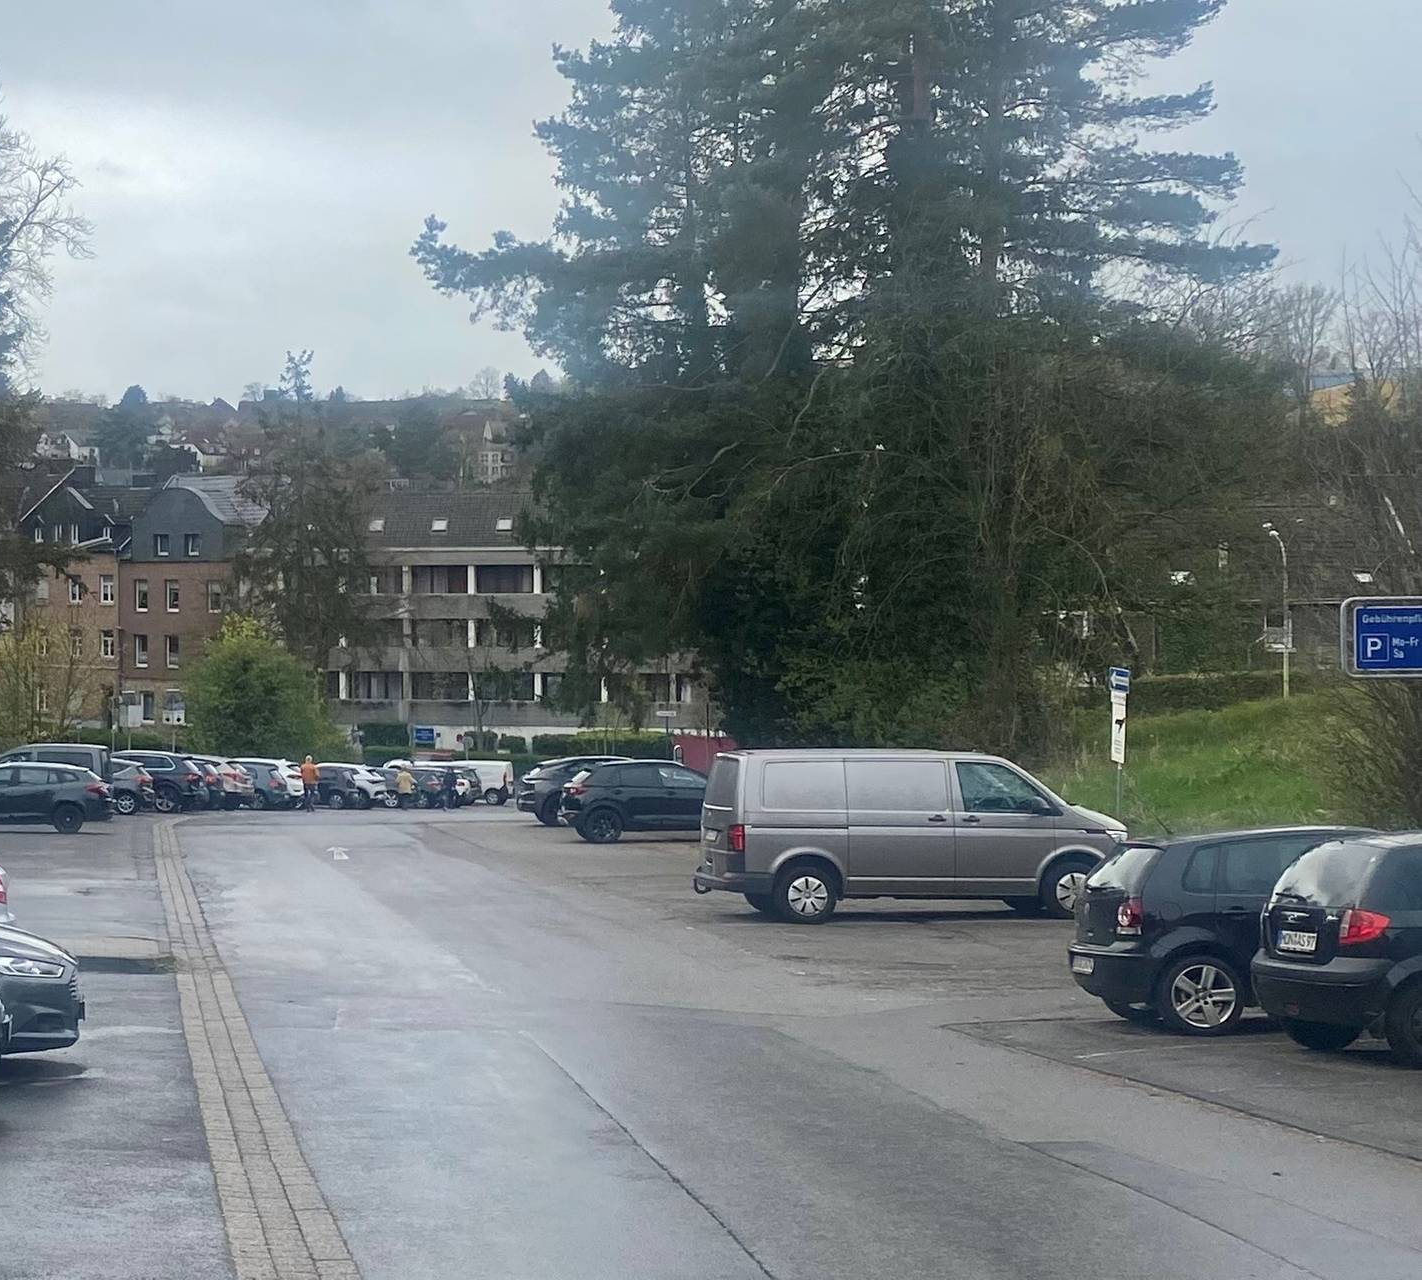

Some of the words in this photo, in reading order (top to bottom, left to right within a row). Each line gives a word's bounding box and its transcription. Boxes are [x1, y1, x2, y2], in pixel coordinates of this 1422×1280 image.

[1392, 636, 1418, 647] Mo-Fr
[1367, 637, 1382, 658] P
[1393, 648, 1404, 658] Sa
